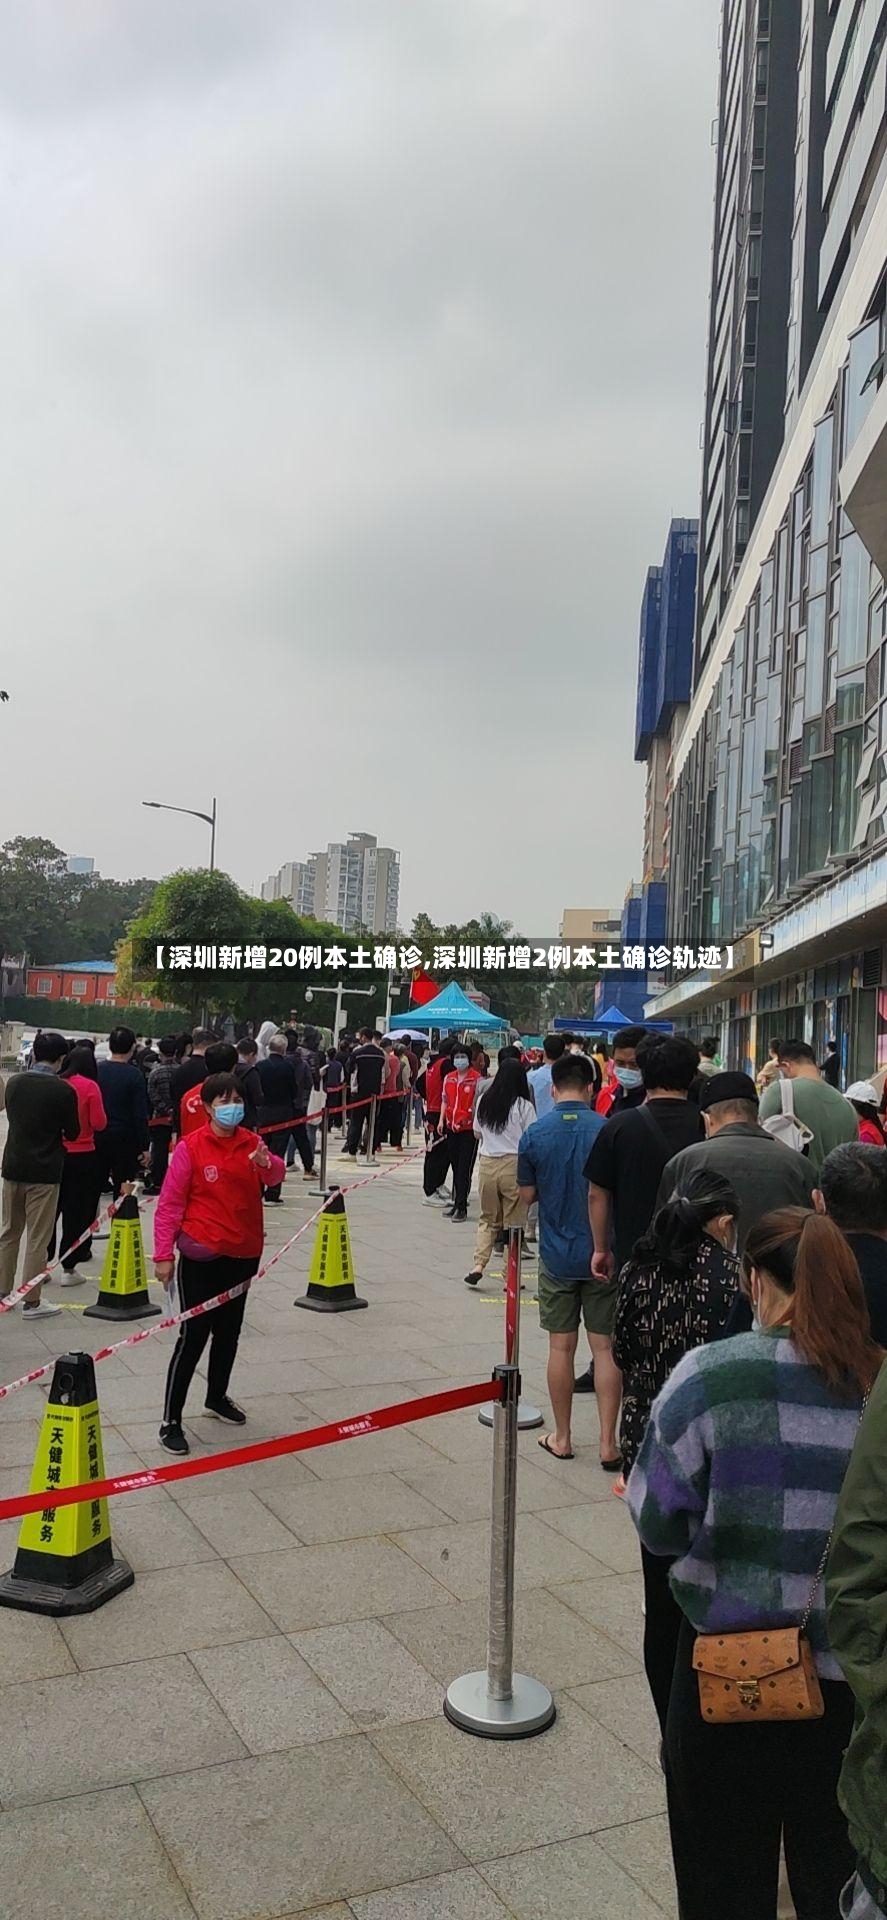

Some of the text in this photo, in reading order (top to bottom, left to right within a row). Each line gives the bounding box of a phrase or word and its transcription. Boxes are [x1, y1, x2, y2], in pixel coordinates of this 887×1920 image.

[87, 1424, 102, 1537] 天健城服务
